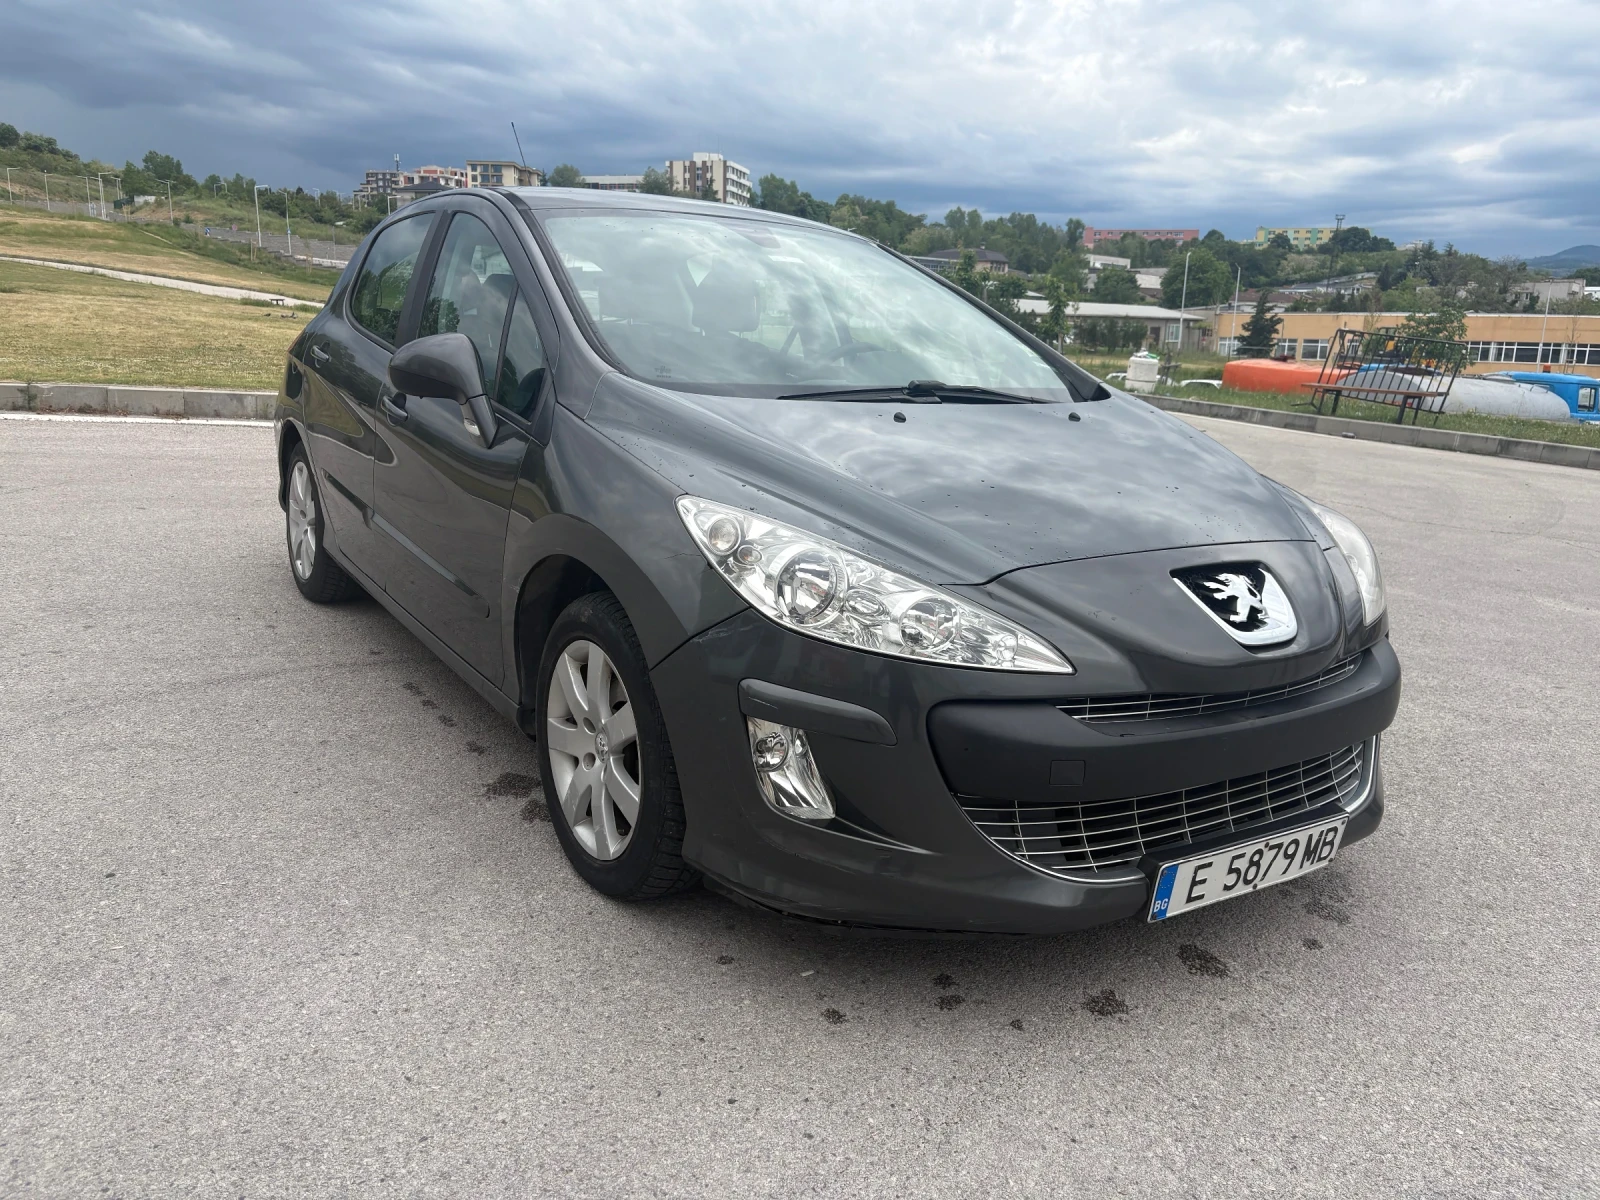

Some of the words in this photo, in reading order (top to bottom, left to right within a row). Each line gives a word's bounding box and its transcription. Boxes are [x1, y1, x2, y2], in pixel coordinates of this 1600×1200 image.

[1185, 861, 1213, 904] E
[1222, 838, 1301, 892] 5879
[1299, 825, 1339, 870] MB
[1153, 898, 1169, 913] BG
